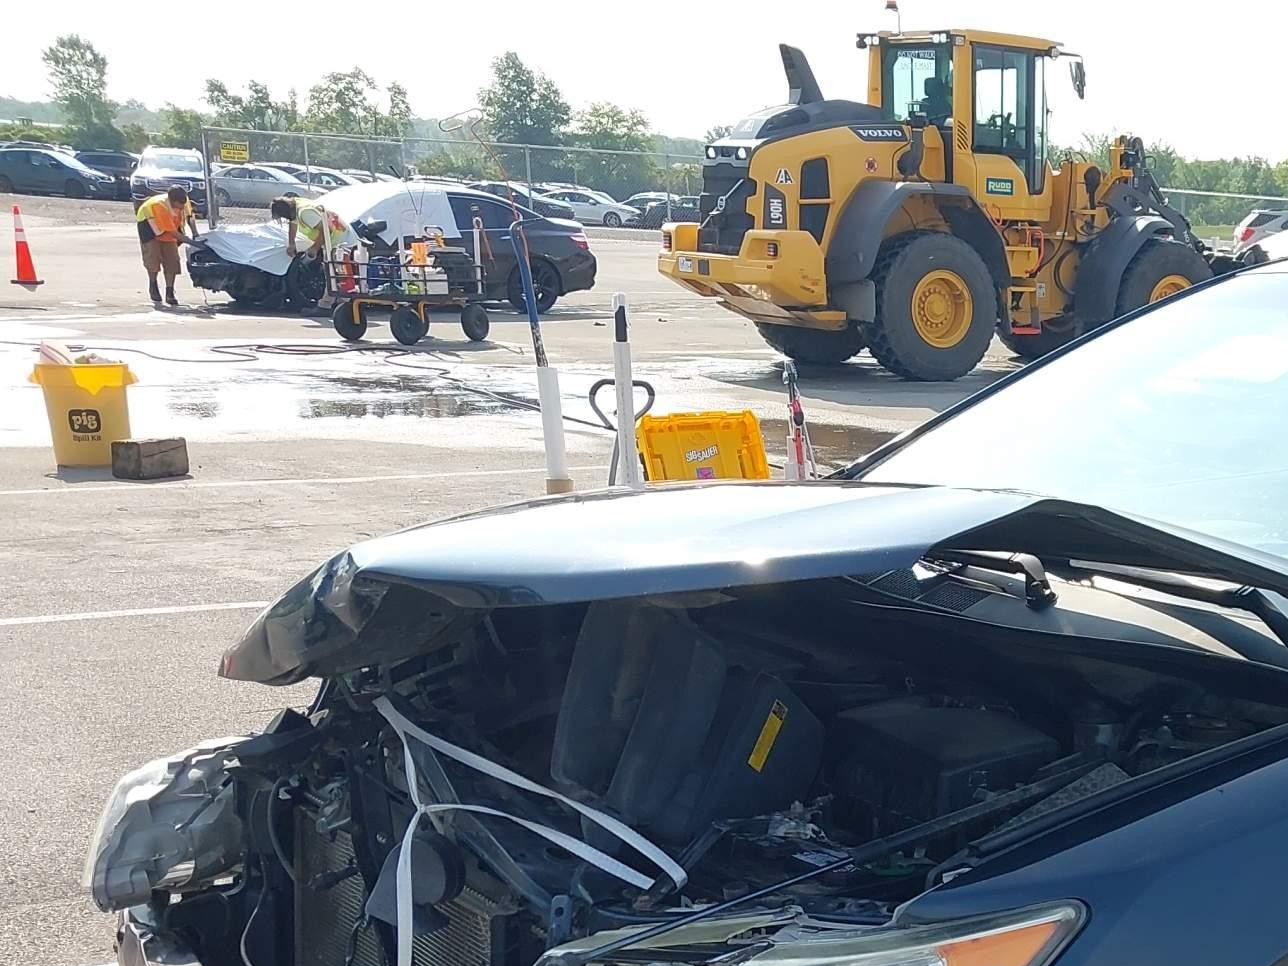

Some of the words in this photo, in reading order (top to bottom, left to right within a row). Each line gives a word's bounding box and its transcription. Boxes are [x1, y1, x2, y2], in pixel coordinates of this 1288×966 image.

[857, 129, 902, 137] VOLVO
[769, 198, 783, 224] L90H
[71, 411, 98, 430] pig
